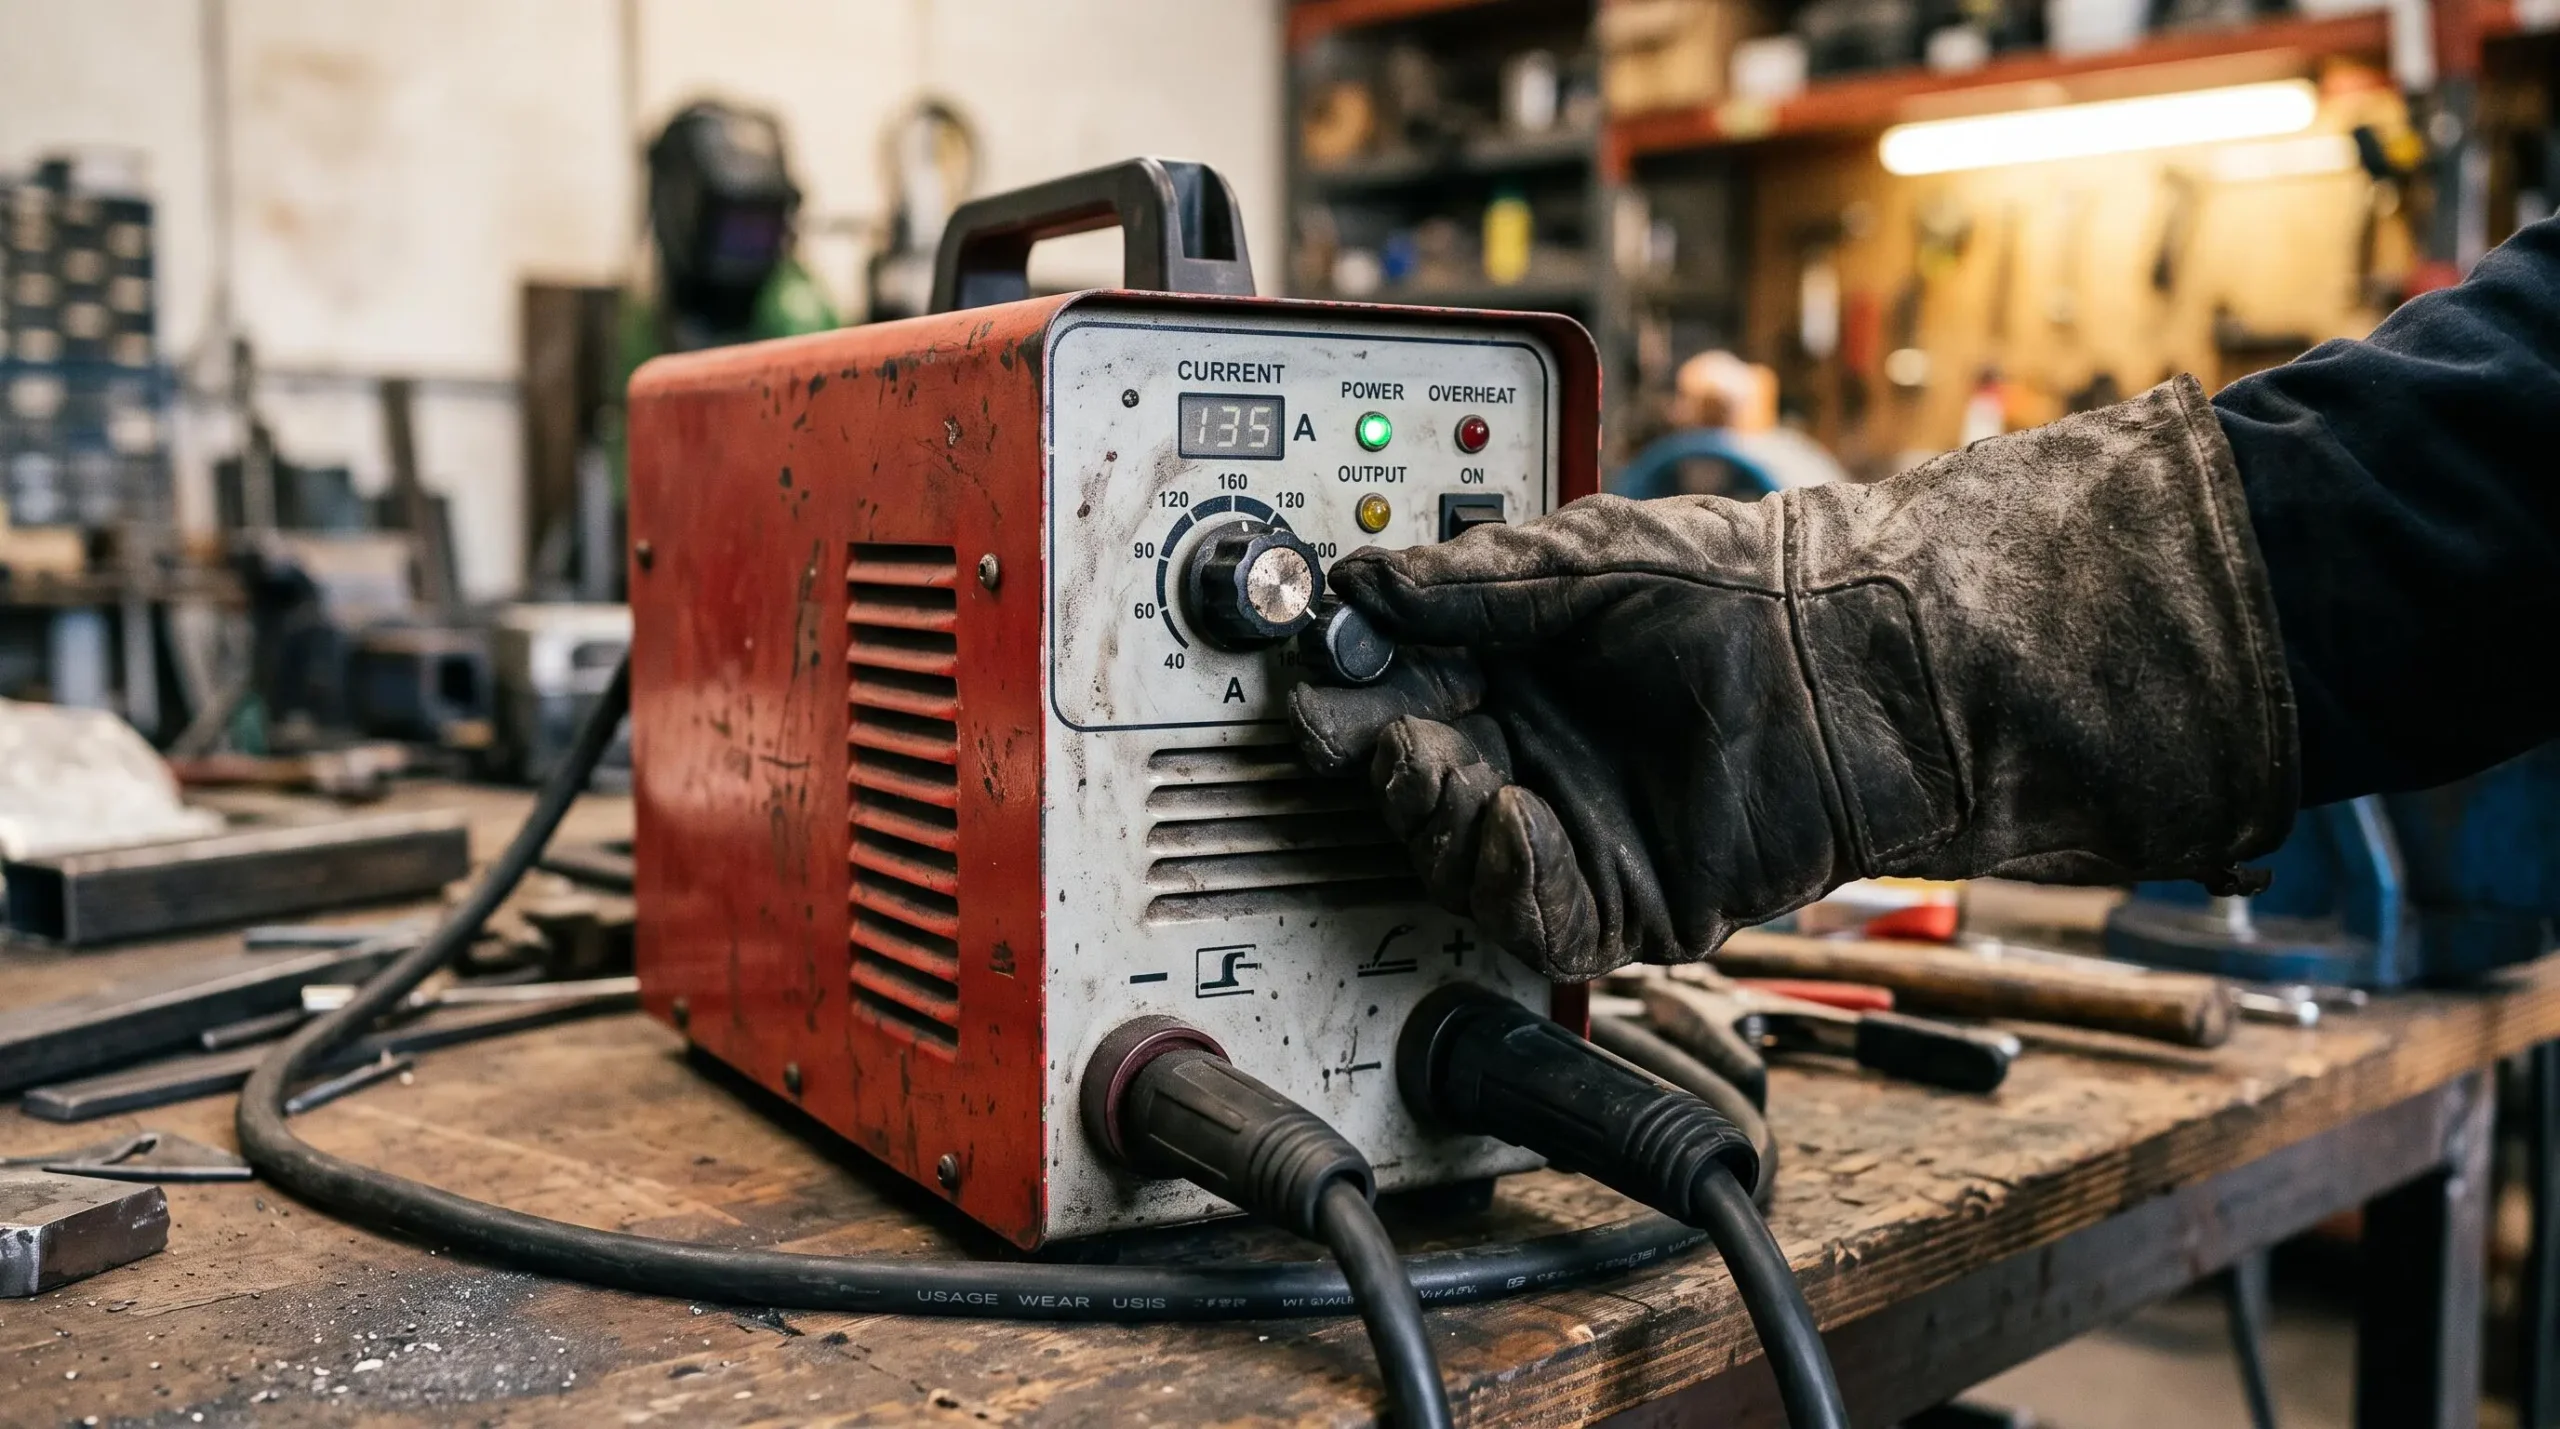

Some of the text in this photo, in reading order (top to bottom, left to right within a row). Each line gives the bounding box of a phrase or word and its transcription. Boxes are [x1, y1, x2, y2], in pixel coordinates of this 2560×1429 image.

[1177, 360, 1285, 384] CURRENT
[1341, 381, 1404, 401] POWER
[1428, 384, 1517, 404] OVERHEAT
[1198, 405, 1271, 448] 135
[1292, 413, 1317, 442] A
[1218, 473, 1248, 490] 160
[1338, 465, 1407, 483] OUTPUT
[1460, 467, 1484, 484] ON
[1158, 491, 1189, 508] 120
[1134, 541, 1155, 558] 90
[1134, 602, 1155, 619] 60
[1164, 652, 1185, 669] 40
[1222, 676, 1246, 704] A
[917, 1290, 1167, 1309] USAGE WEAR USIS
